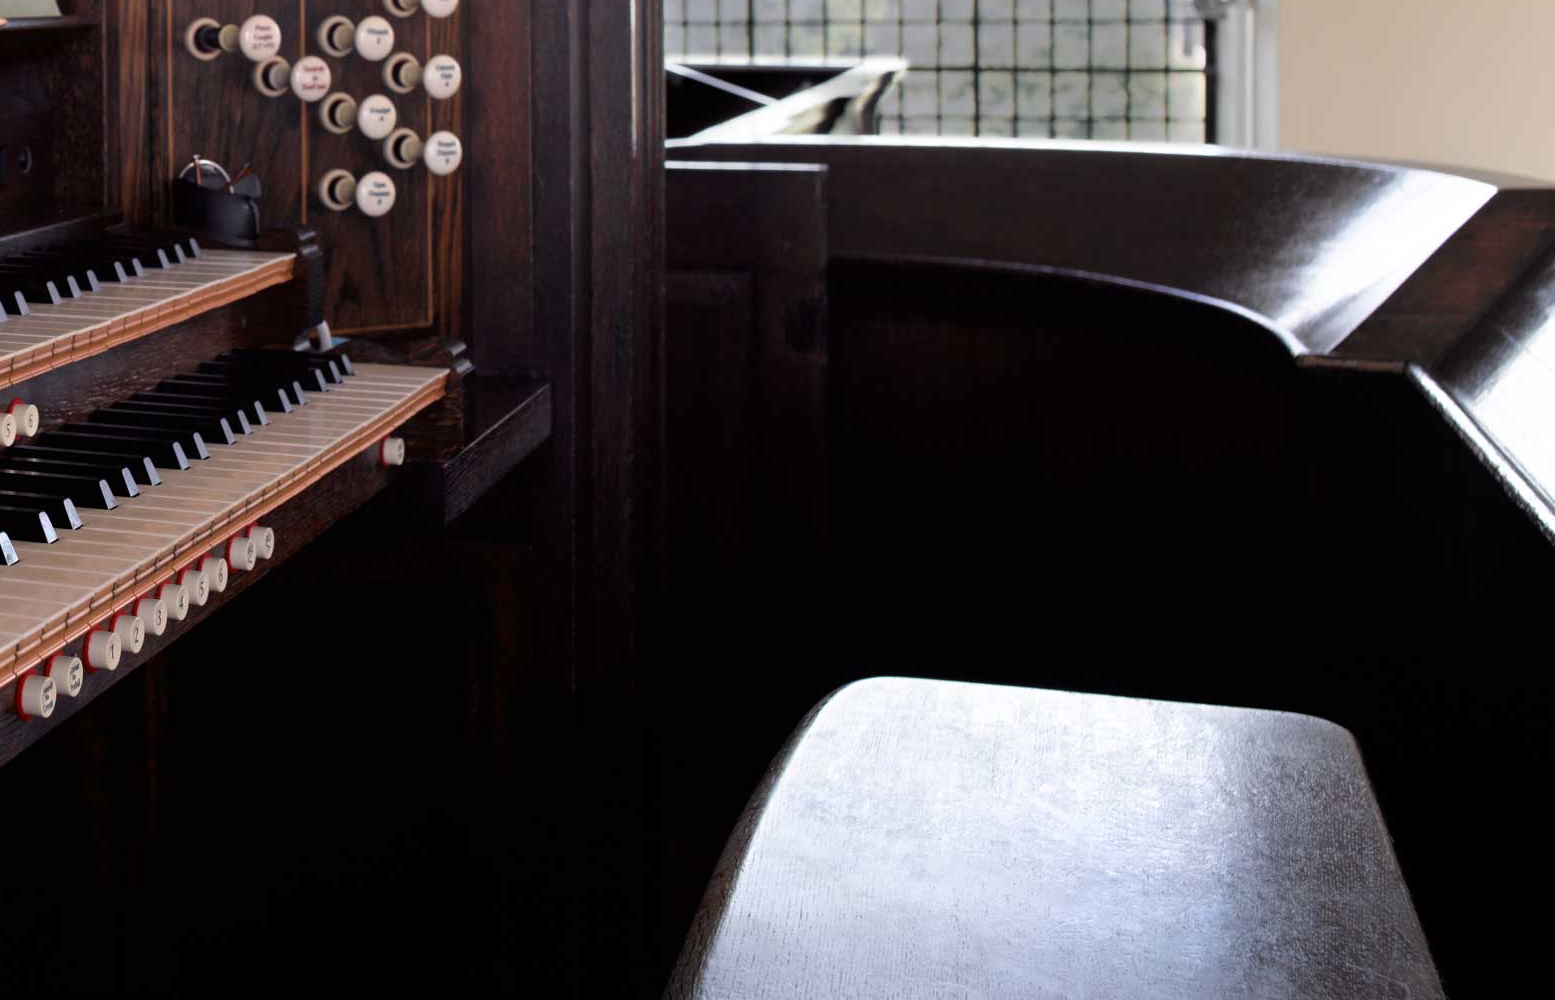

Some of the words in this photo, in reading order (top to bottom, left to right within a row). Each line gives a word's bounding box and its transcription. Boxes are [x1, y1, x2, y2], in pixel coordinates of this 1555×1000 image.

[5, 424, 11, 438] 5
[198, 580, 204, 596] 5
[178, 594, 184, 610] 4
[156, 609, 162, 626] 3
[134, 628, 140, 644] 2
[110, 644, 115, 659] 1
